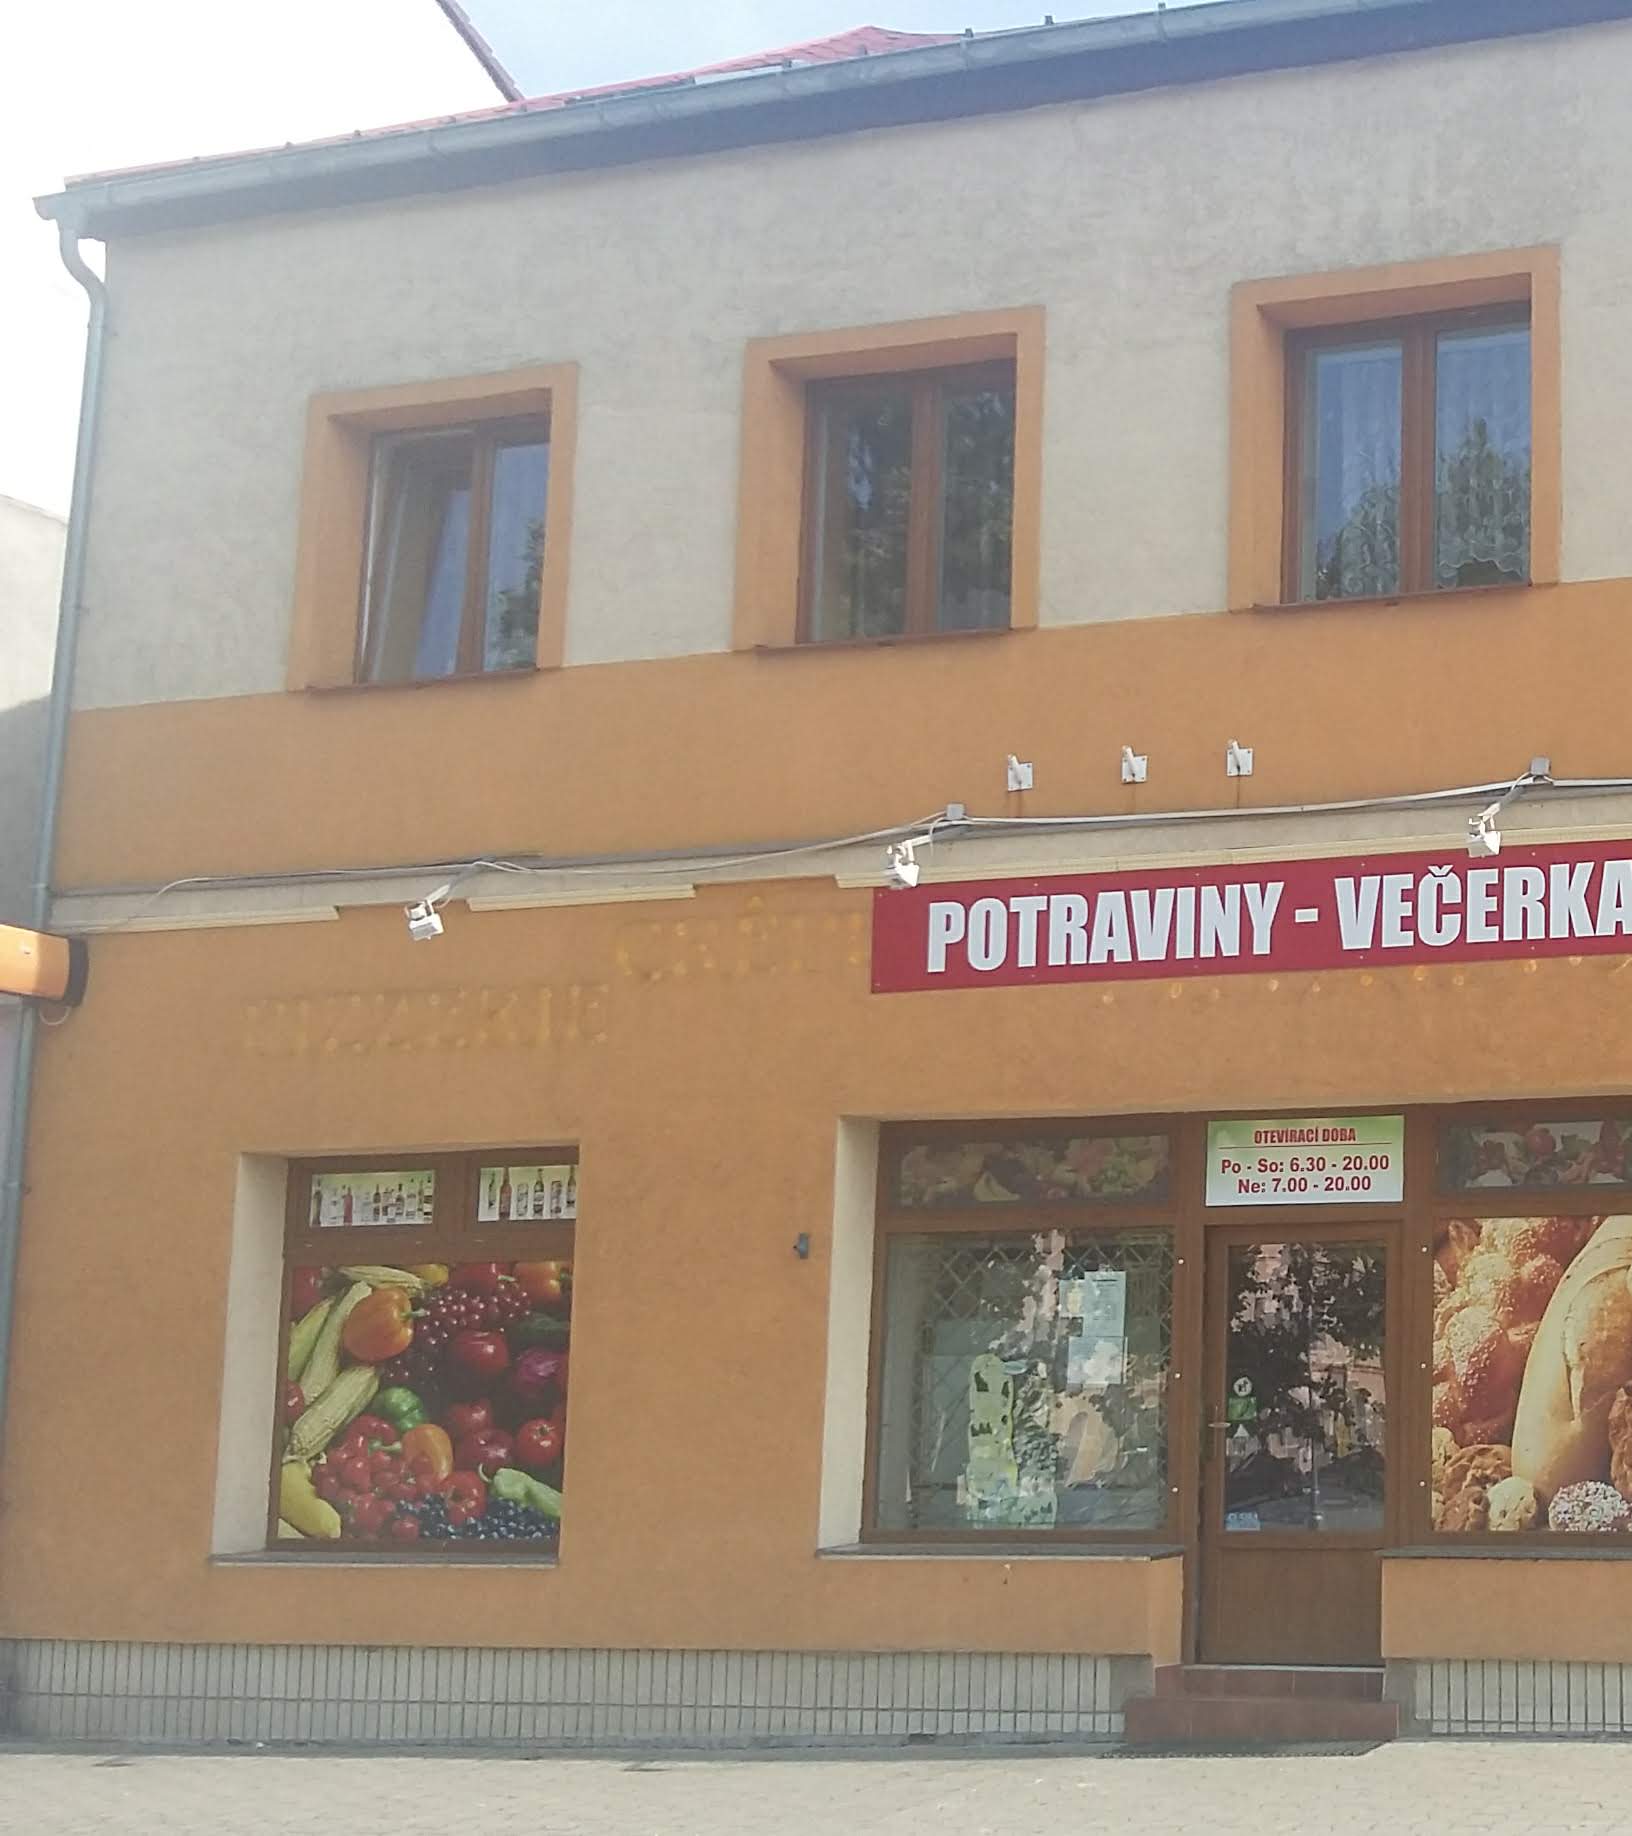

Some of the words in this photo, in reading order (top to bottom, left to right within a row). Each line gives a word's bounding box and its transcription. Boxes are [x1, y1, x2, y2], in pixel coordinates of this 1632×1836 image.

[926, 881, 1284, 974] POTRAVINY
[1295, 908, 1318, 923] -
[1254, 1127, 1319, 1144] OTEVÍRACÍ
[1322, 1128, 1356, 1142] DOBA
[1221, 1159, 1241, 1174] Po
[1257, 1158, 1284, 1173] So:
[1290, 1157, 1326, 1172] 6.30
[1342, 1155, 1389, 1171] 20.00
[1238, 1179, 1266, 1194] Ne:
[1272, 1177, 1307, 1193] 7.00
[1324, 1176, 1371, 1191] 20.00
